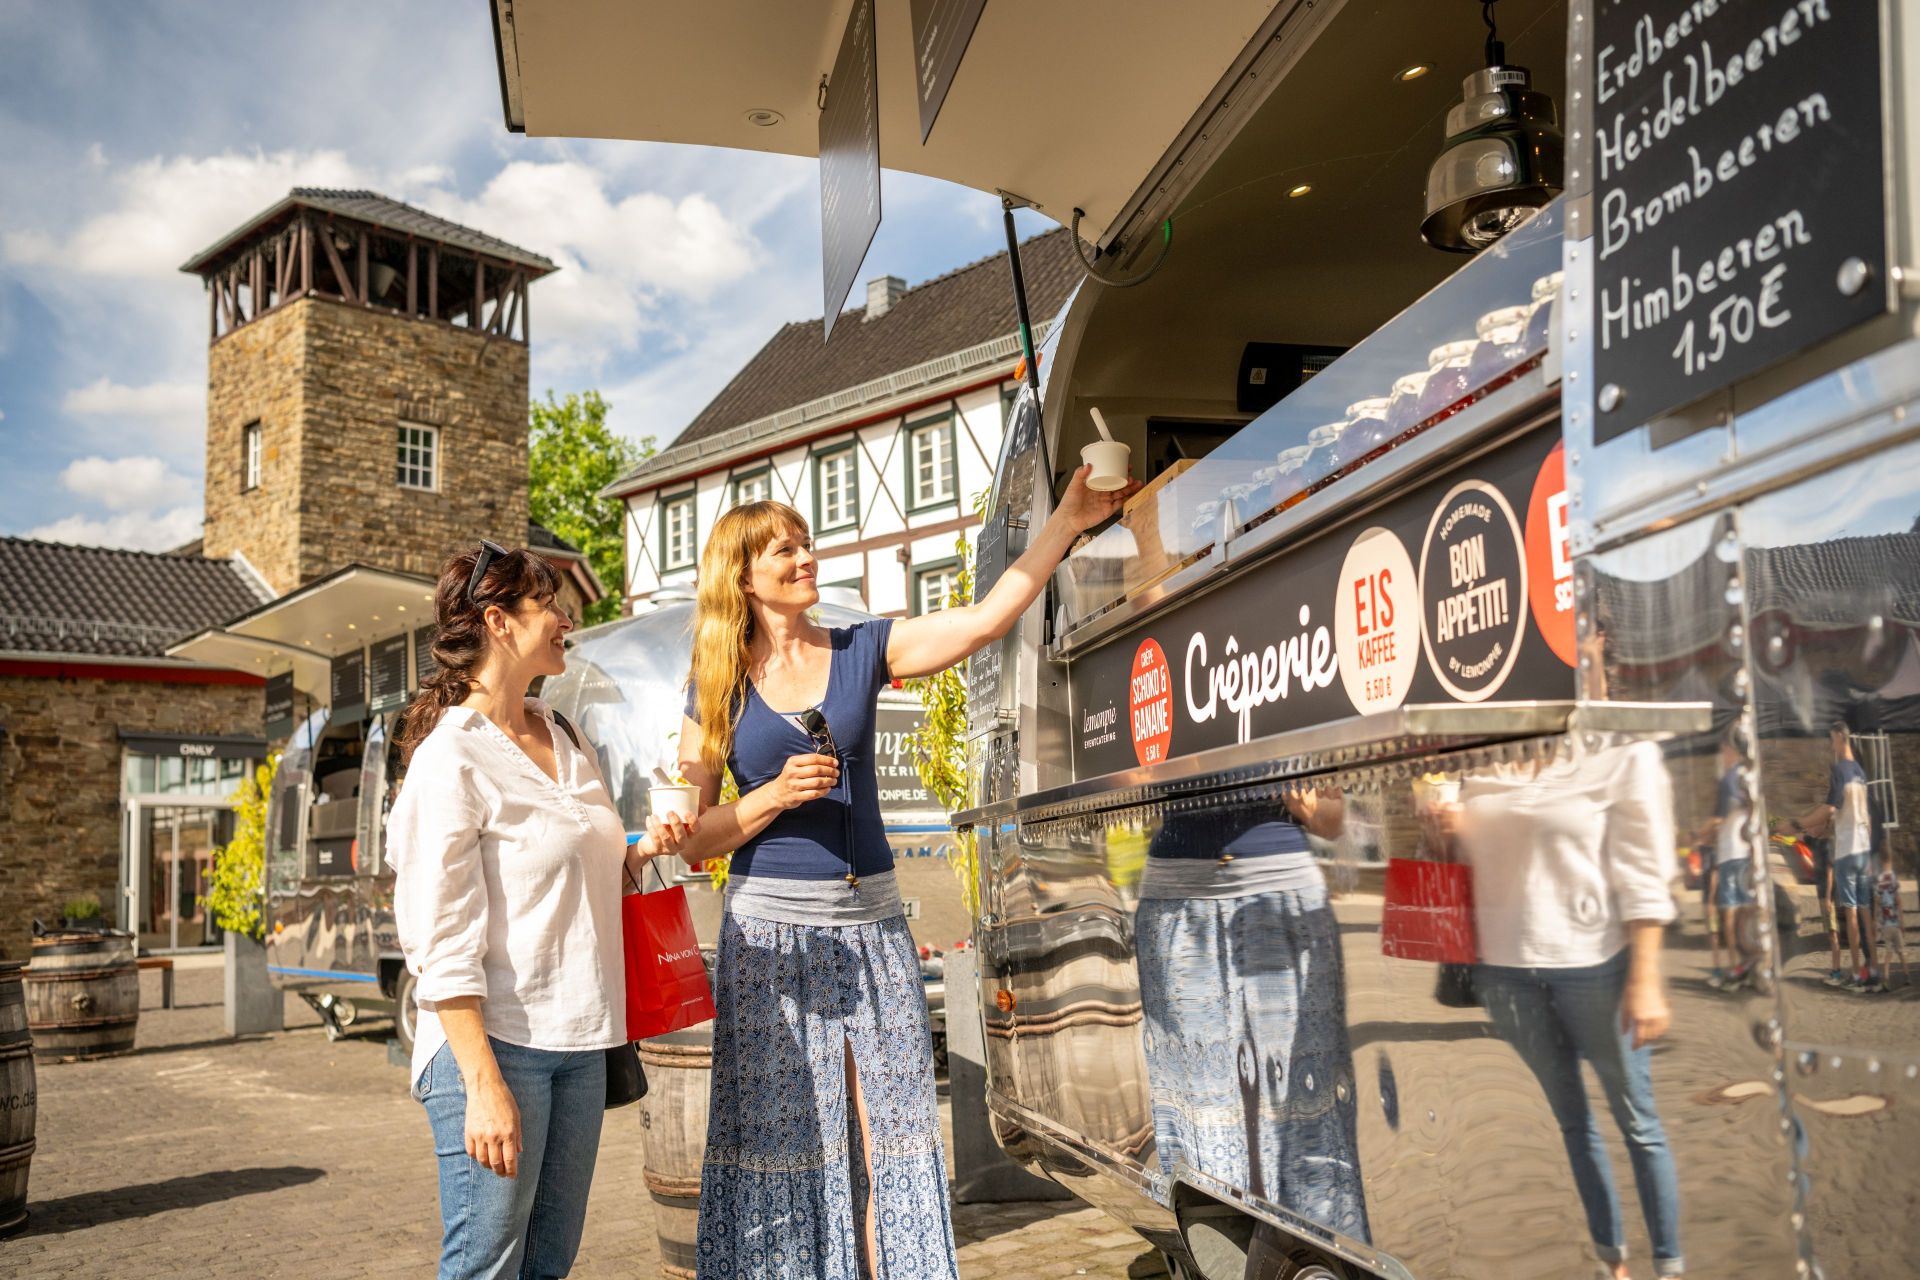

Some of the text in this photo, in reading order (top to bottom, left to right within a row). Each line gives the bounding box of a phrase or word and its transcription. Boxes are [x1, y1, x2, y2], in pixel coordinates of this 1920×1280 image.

[1598, 0, 1727, 104] Erdbeere
[1597, 0, 1831, 180] Heidelbeeren
[1600, 92, 1831, 260] Brombeeren
[1601, 209, 1812, 350] Himbeeren
[1440, 503, 1493, 540] HOMEMADE
[1449, 533, 1486, 588] BON
[1354, 568, 1394, 637] EIS
[1437, 578, 1509, 643] APPÉTIT!
[1185, 604, 1338, 744] Crêperie
[1358, 631, 1396, 670] KAFFEE
[1449, 642, 1503, 679] BY LEMONPIE
[1132, 664, 1167, 705] SCHOKO &
[1083, 699, 1118, 734] lemonpie
[1134, 697, 1168, 743] BANANE
[179, 743, 215, 756] ONLY
